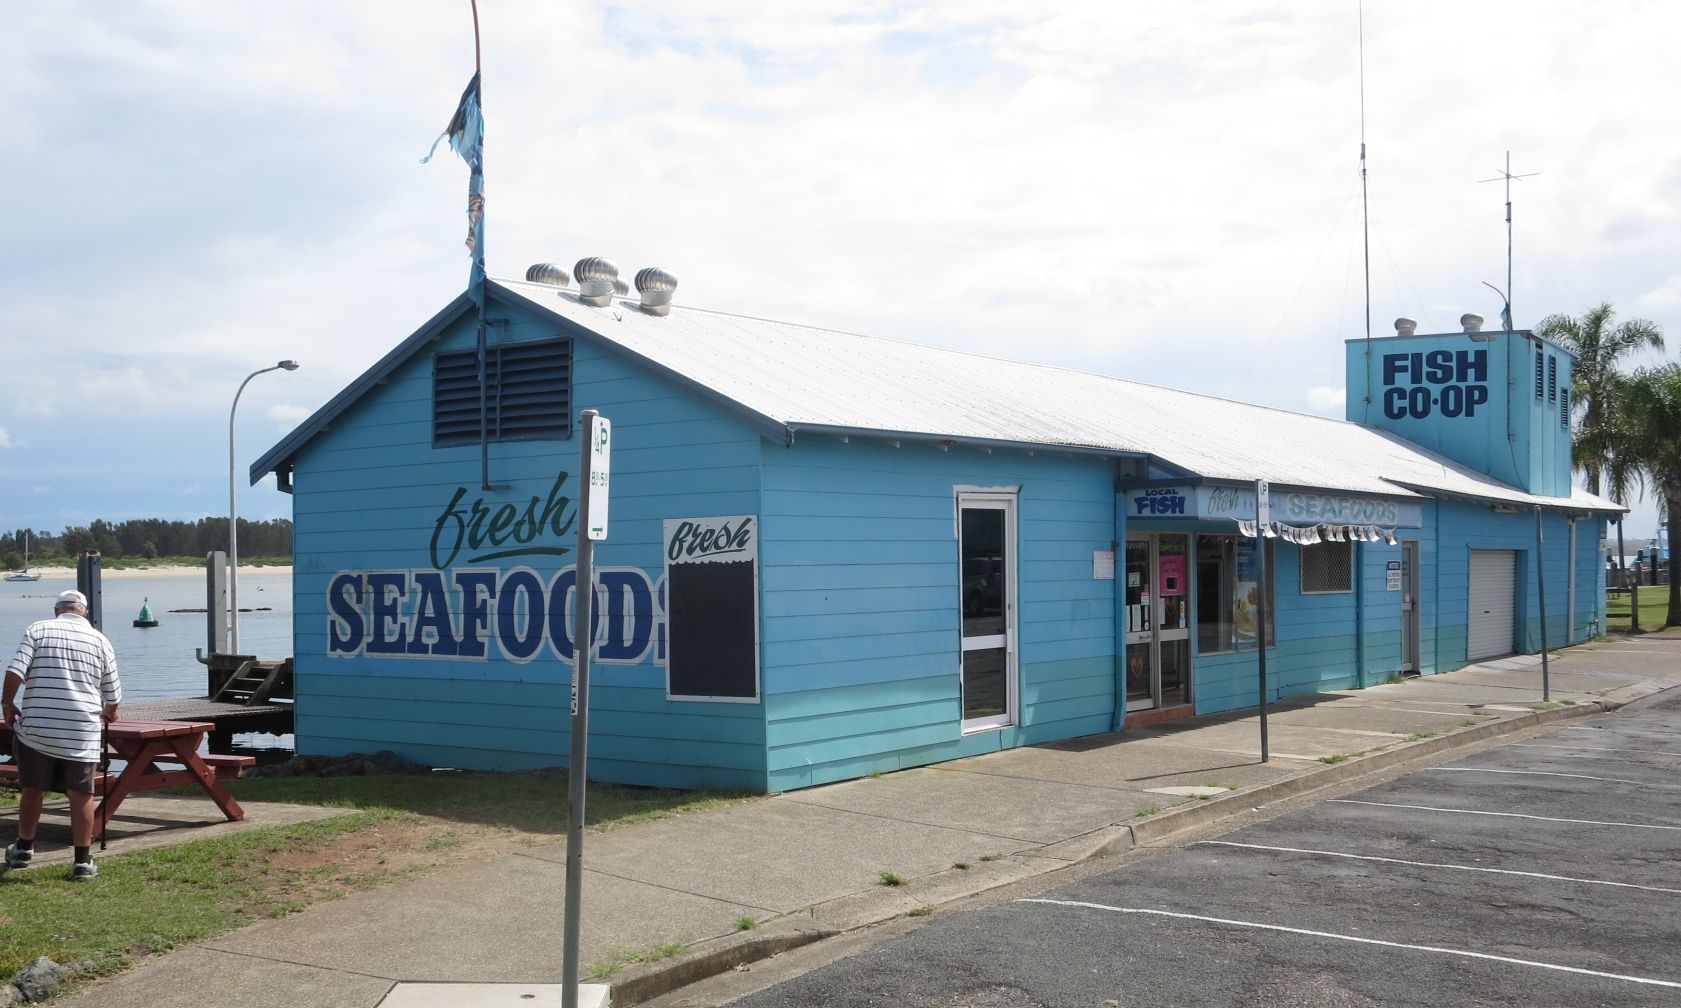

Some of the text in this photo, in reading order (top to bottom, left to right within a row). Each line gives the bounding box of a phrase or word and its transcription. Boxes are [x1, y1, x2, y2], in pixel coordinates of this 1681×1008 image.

[1383, 350, 1487, 385] FISH
[1134, 495, 1186, 514] FISH
[1145, 488, 1179, 496] LOCAL
[1289, 494, 1398, 523] SEAFOODS
[429, 471, 577, 570] fresh
[667, 517, 752, 560] fresh
[327, 567, 666, 663] SEAFOOD
